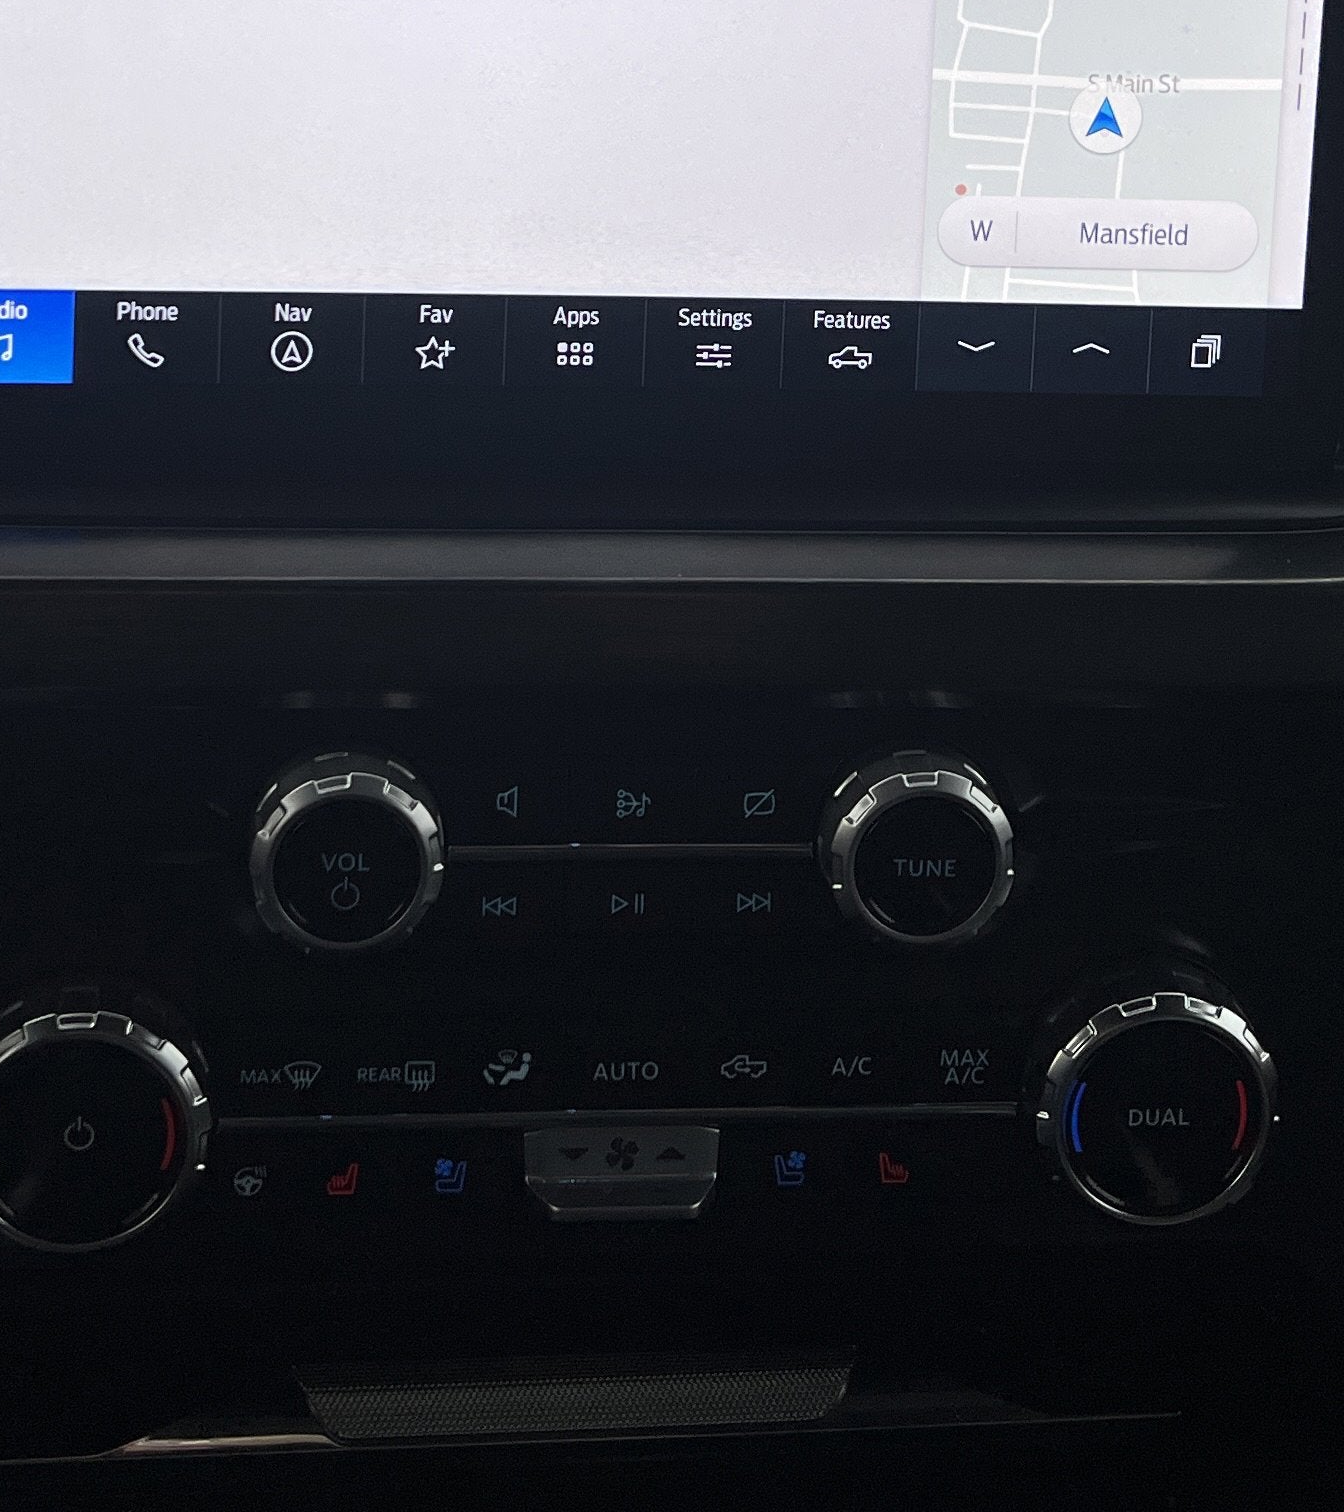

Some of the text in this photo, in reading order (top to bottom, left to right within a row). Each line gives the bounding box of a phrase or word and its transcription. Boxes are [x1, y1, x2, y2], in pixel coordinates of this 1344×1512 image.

[1105, 74, 1154, 93] Main
[1158, 74, 1181, 94] St
[970, 220, 993, 242] W
[1079, 221, 1189, 246] Mansfield
[116, 301, 179, 323] Phone
[274, 303, 313, 322] Nav
[419, 305, 453, 324] Fav
[553, 306, 600, 328] Apps
[677, 307, 753, 331] Settings
[813, 309, 891, 331] Features
[320, 852, 370, 874] VOL
[893, 858, 957, 879] TUNE
[832, 1055, 873, 1077] A/C
[940, 1048, 991, 1068] MAX
[239, 1067, 282, 1085] MAX
[357, 1066, 403, 1085] REAR
[593, 1060, 660, 1083] AUTO
[943, 1065, 985, 1086] A/C
[1128, 1106, 1191, 1128] DUAL
